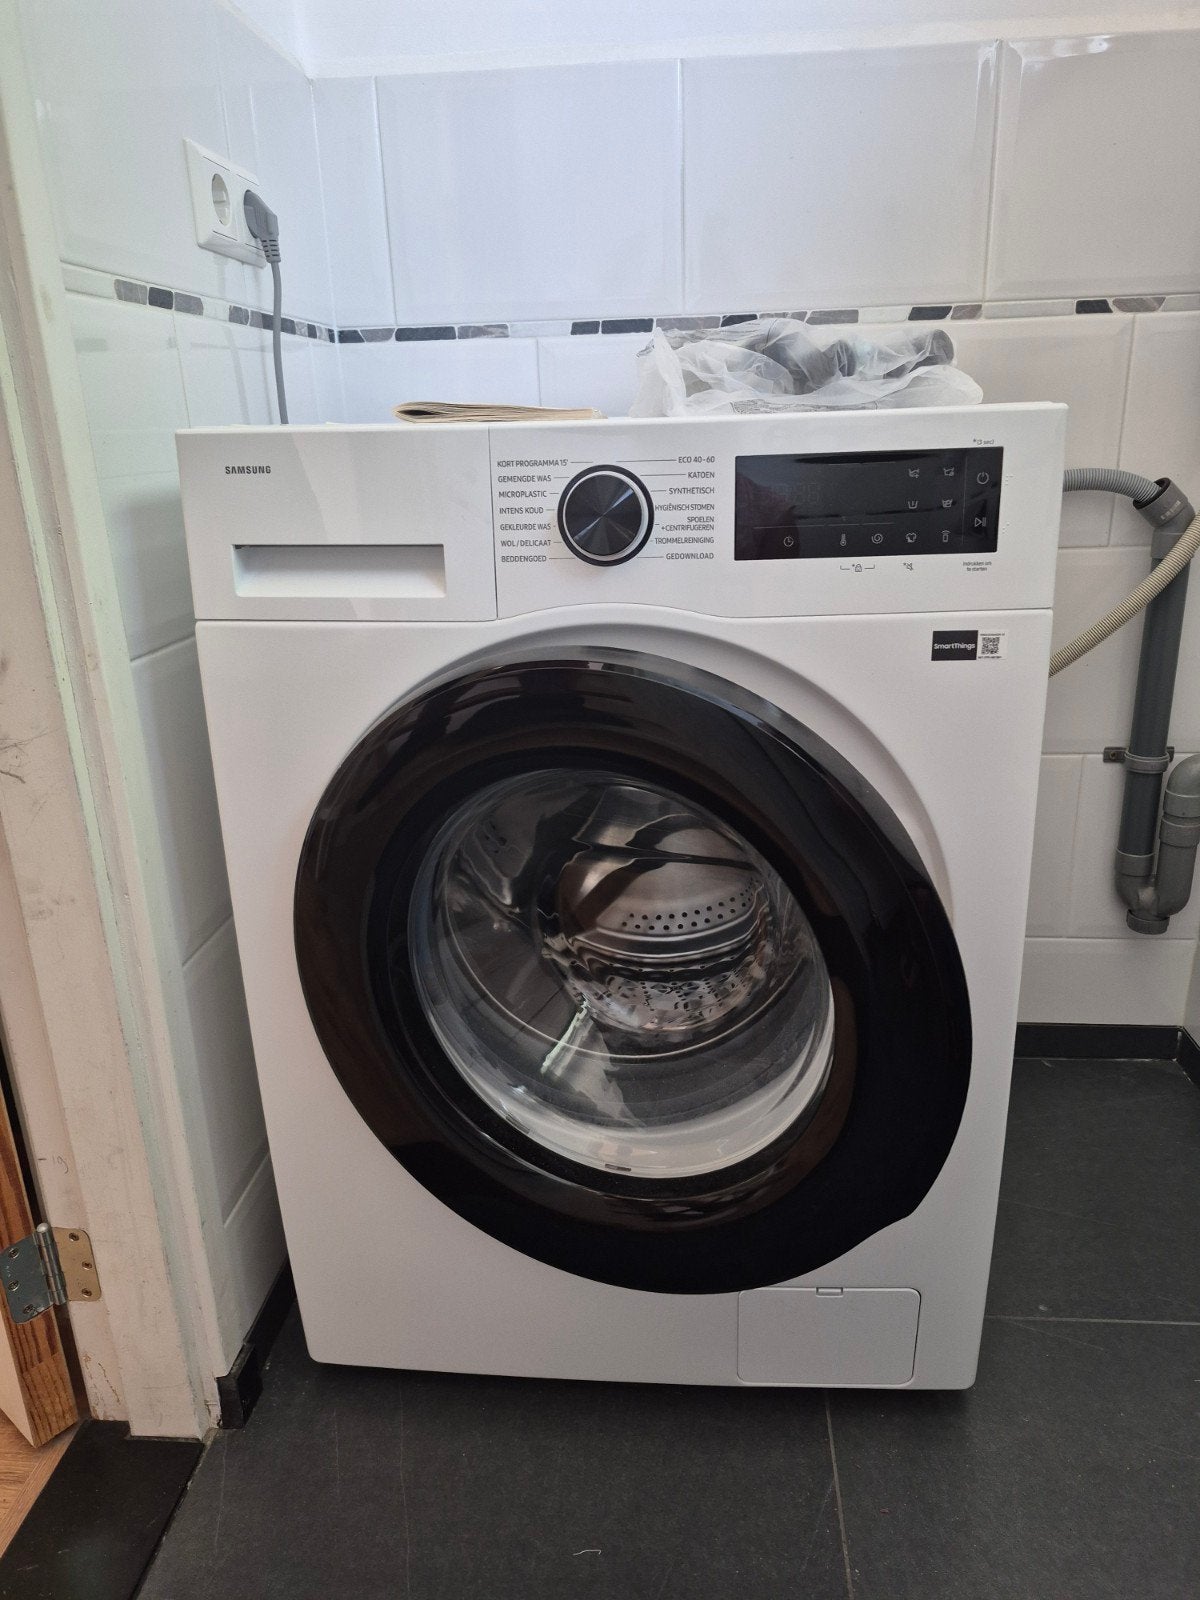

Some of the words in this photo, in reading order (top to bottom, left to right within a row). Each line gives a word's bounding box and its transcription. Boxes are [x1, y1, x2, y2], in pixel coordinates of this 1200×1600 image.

[497, 460, 515, 468] KORT
[515, 459, 560, 467] PROGRAMMA
[678, 456, 693, 464] ECO
[224, 465, 272, 475] SAMSUNG
[497, 475, 536, 483] GEMENGDE
[536, 474, 552, 482] WAS
[687, 471, 715, 479] KATOEN
[498, 490, 548, 498] MICROPLASTIC
[668, 486, 715, 494] SYNTHETISCH
[499, 507, 524, 515] INTENS
[524, 506, 544, 514] KOUD
[690, 503, 715, 511] STOMEN
[686, 516, 715, 524] SPOELEN
[499, 523, 537, 531] GEKLEURDE
[537, 523, 552, 531] WAS
[500, 540, 516, 548] WOL
[520, 539, 552, 547] DELICAAT
[654, 536, 715, 545] TROMMELREINIGING
[501, 555, 548, 563] BEDDENGOED
[665, 552, 715, 560] GEDOWNLOAD
[933, 642, 976, 651] SmartThings
